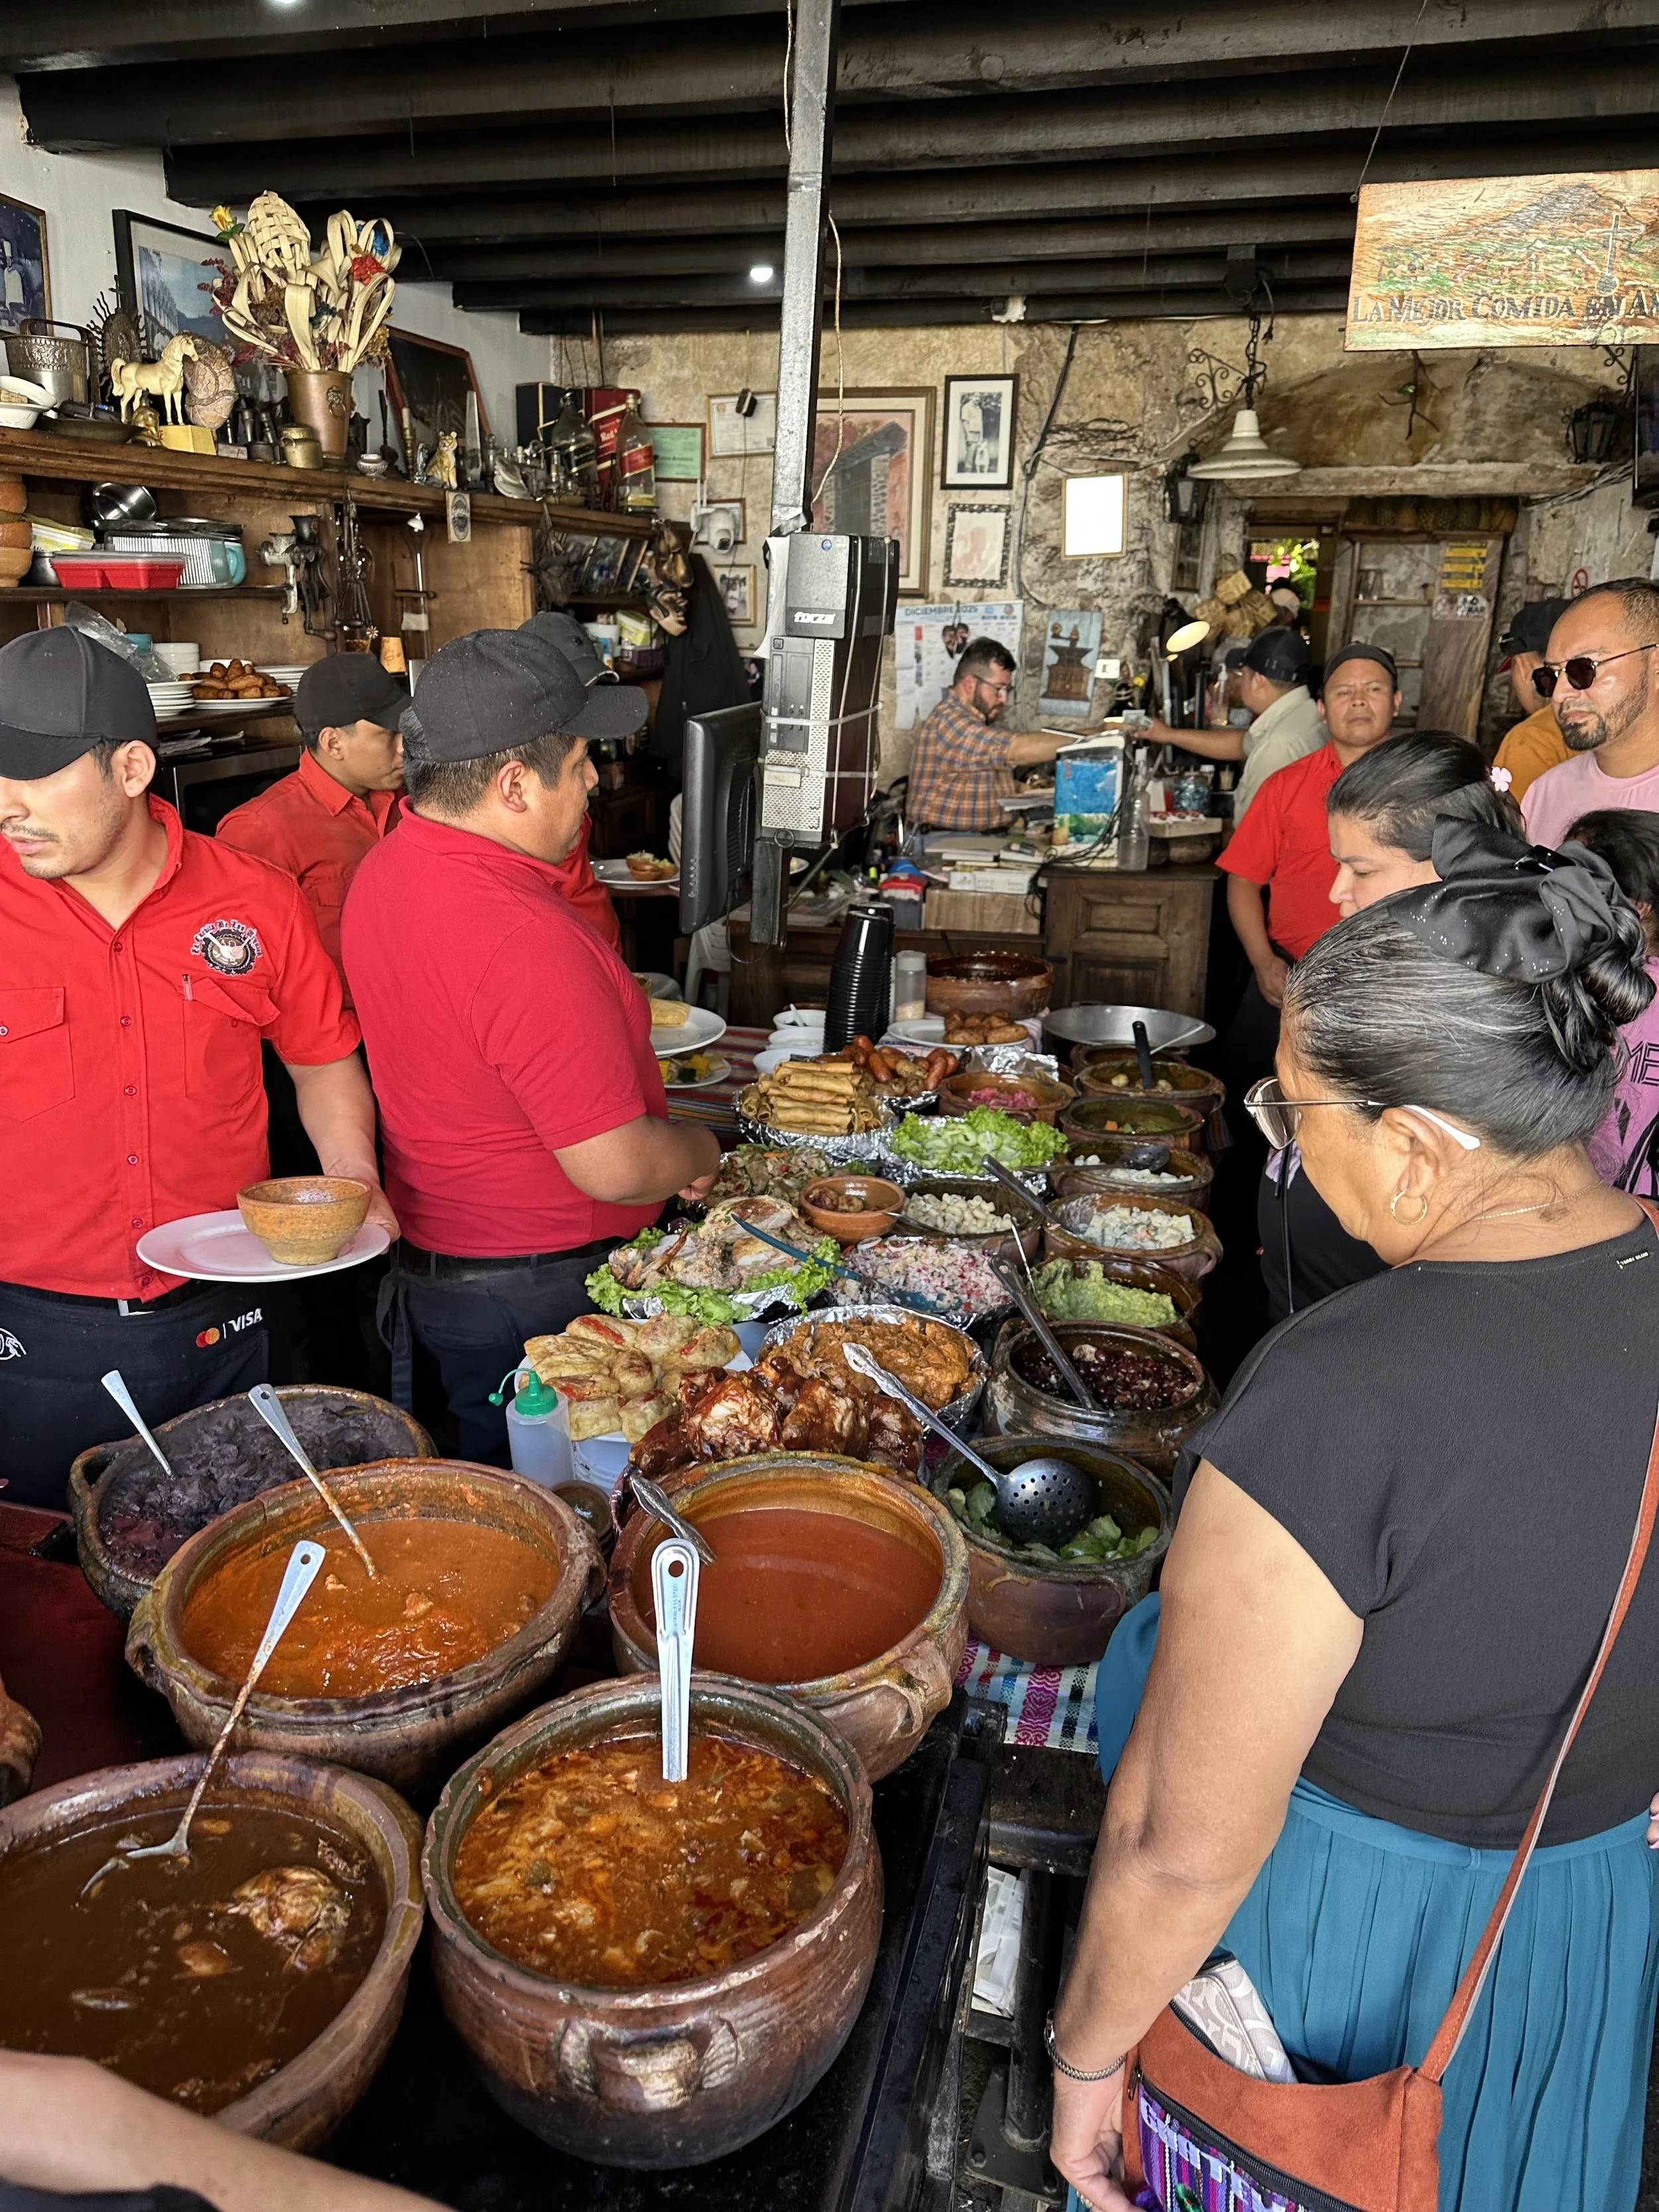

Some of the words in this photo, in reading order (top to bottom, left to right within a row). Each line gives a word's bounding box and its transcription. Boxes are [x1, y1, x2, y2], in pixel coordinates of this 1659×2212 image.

[1352, 296, 1384, 323] LA
[1390, 296, 1467, 325] MEJOR
[1472, 295, 1575, 320] COMIDA
[228, 1307, 263, 1332] VISA
